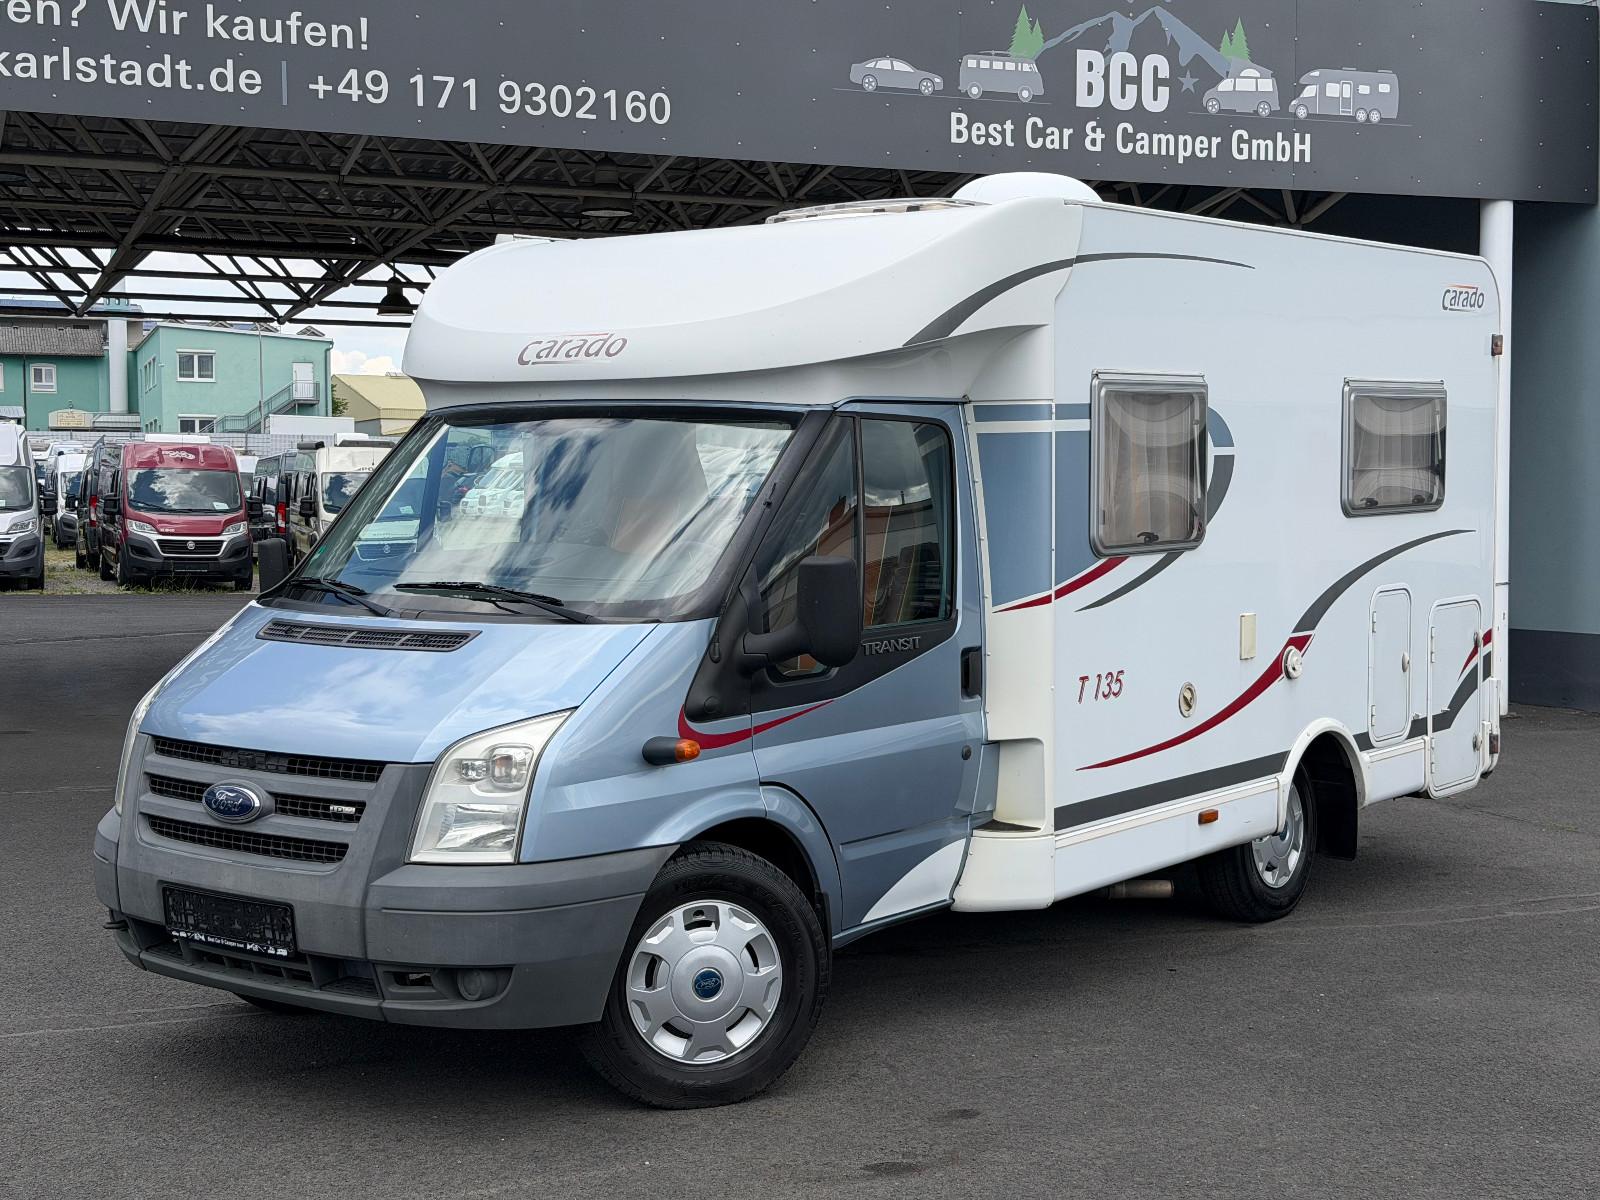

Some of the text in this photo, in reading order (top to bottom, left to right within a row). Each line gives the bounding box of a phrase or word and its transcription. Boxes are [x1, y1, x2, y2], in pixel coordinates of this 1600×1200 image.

[0, 0, 368, 50] en? Wir kaufen!
[308, 68, 389, 104] +49
[409, 74, 478, 111] 171
[498, 80, 671, 125] 9302160
[1076, 48, 1170, 113] BCC
[949, 111, 1312, 164] Best Car & Camper GmbH
[862, 636, 921, 656] TRANSIT
[1078, 669, 1124, 704] T 135
[211, 789, 242, 812] Ford
